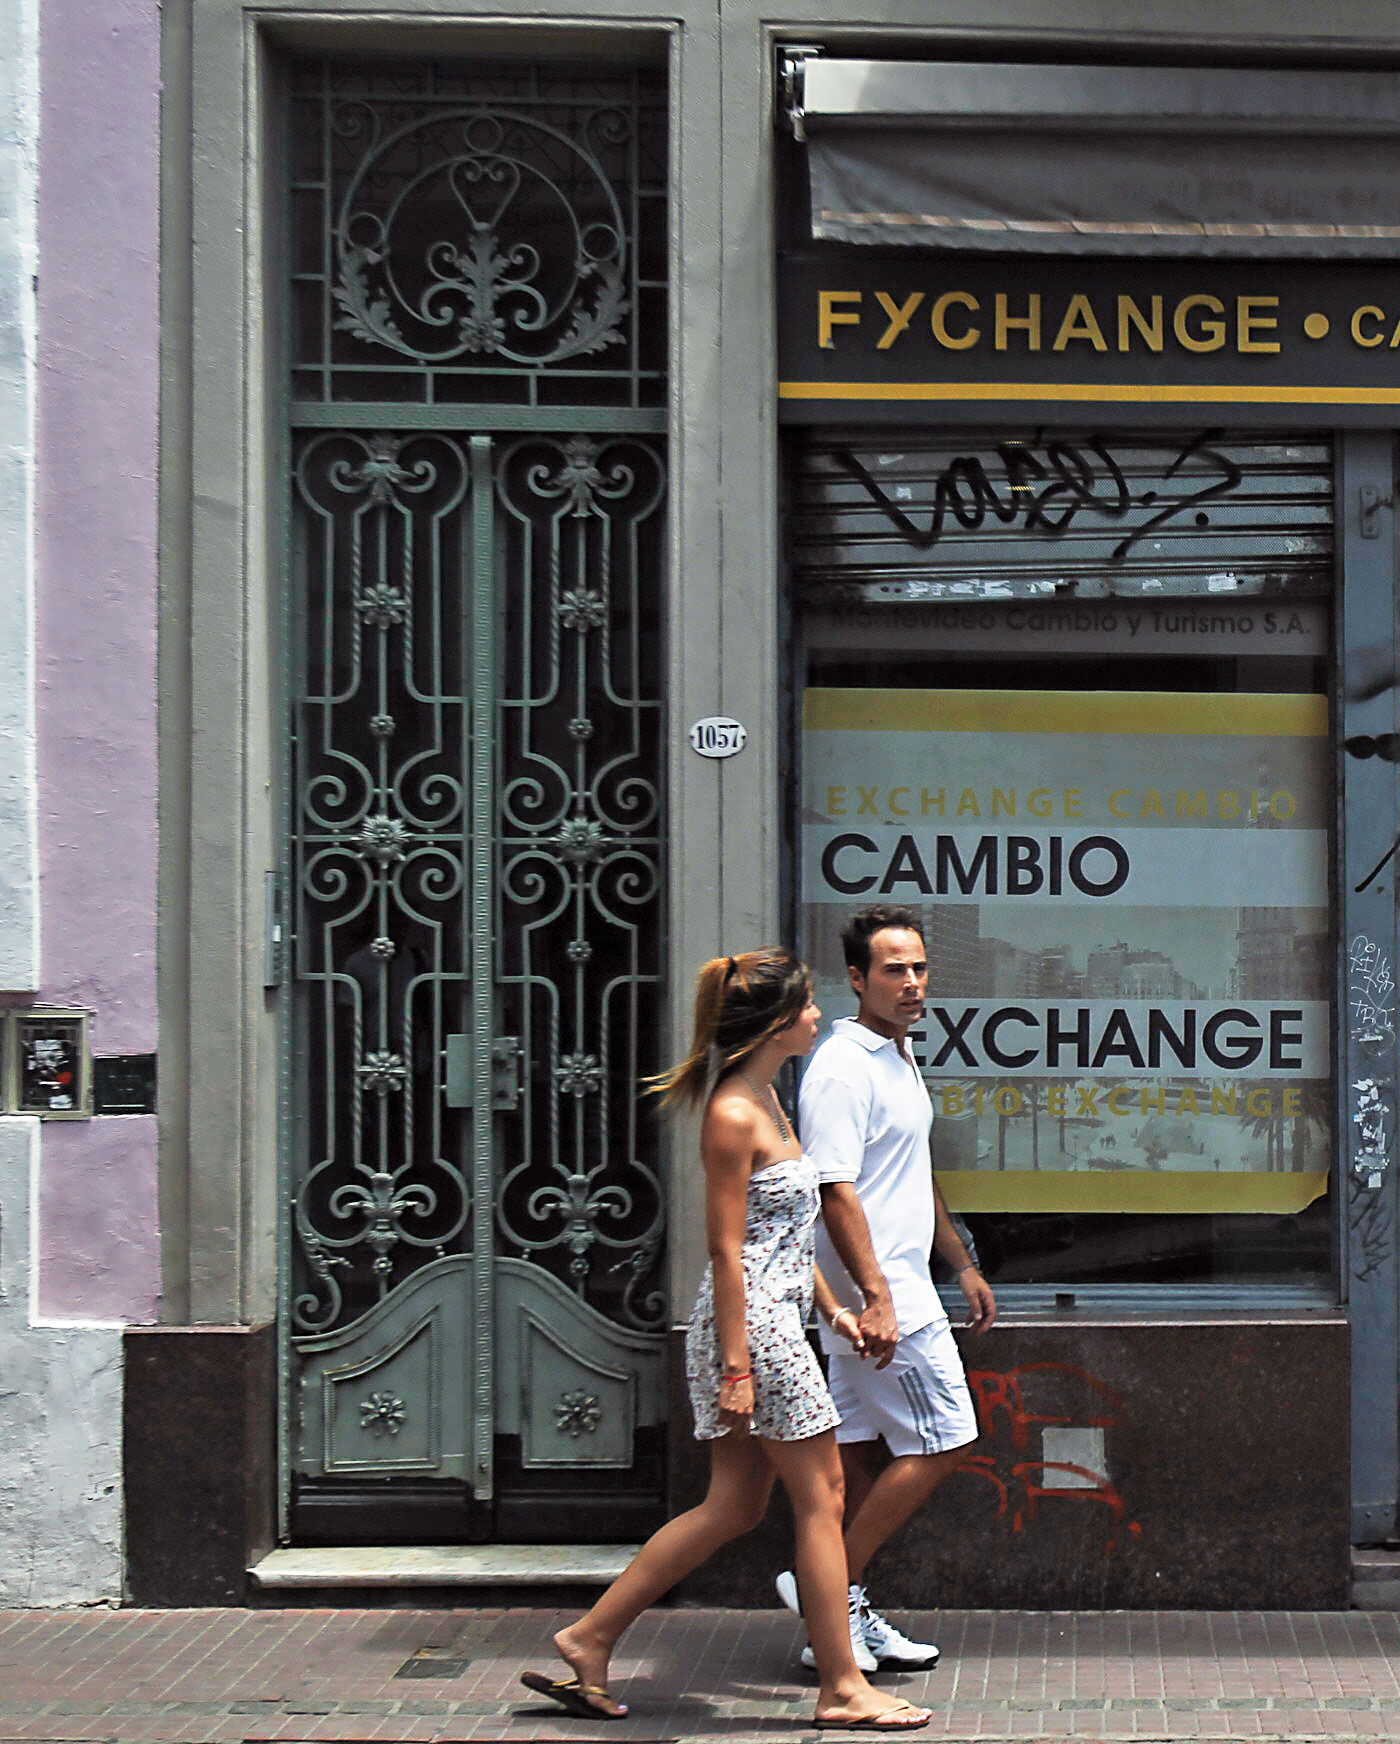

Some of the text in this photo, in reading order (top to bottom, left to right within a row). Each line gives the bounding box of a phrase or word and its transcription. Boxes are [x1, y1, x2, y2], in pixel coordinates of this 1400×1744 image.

[1006, 608, 1118, 633] Cambio
[1127, 616, 1142, 637] y
[1152, 610, 1253, 634] Turismo
[1263, 612, 1312, 635] S.A.
[697, 724, 740, 749] 1057
[826, 785, 1298, 820] EXCHANGE CAMBIO
[821, 832, 1131, 897] CAMBIO
[1047, 1087, 1302, 1118] EXCHANGE
